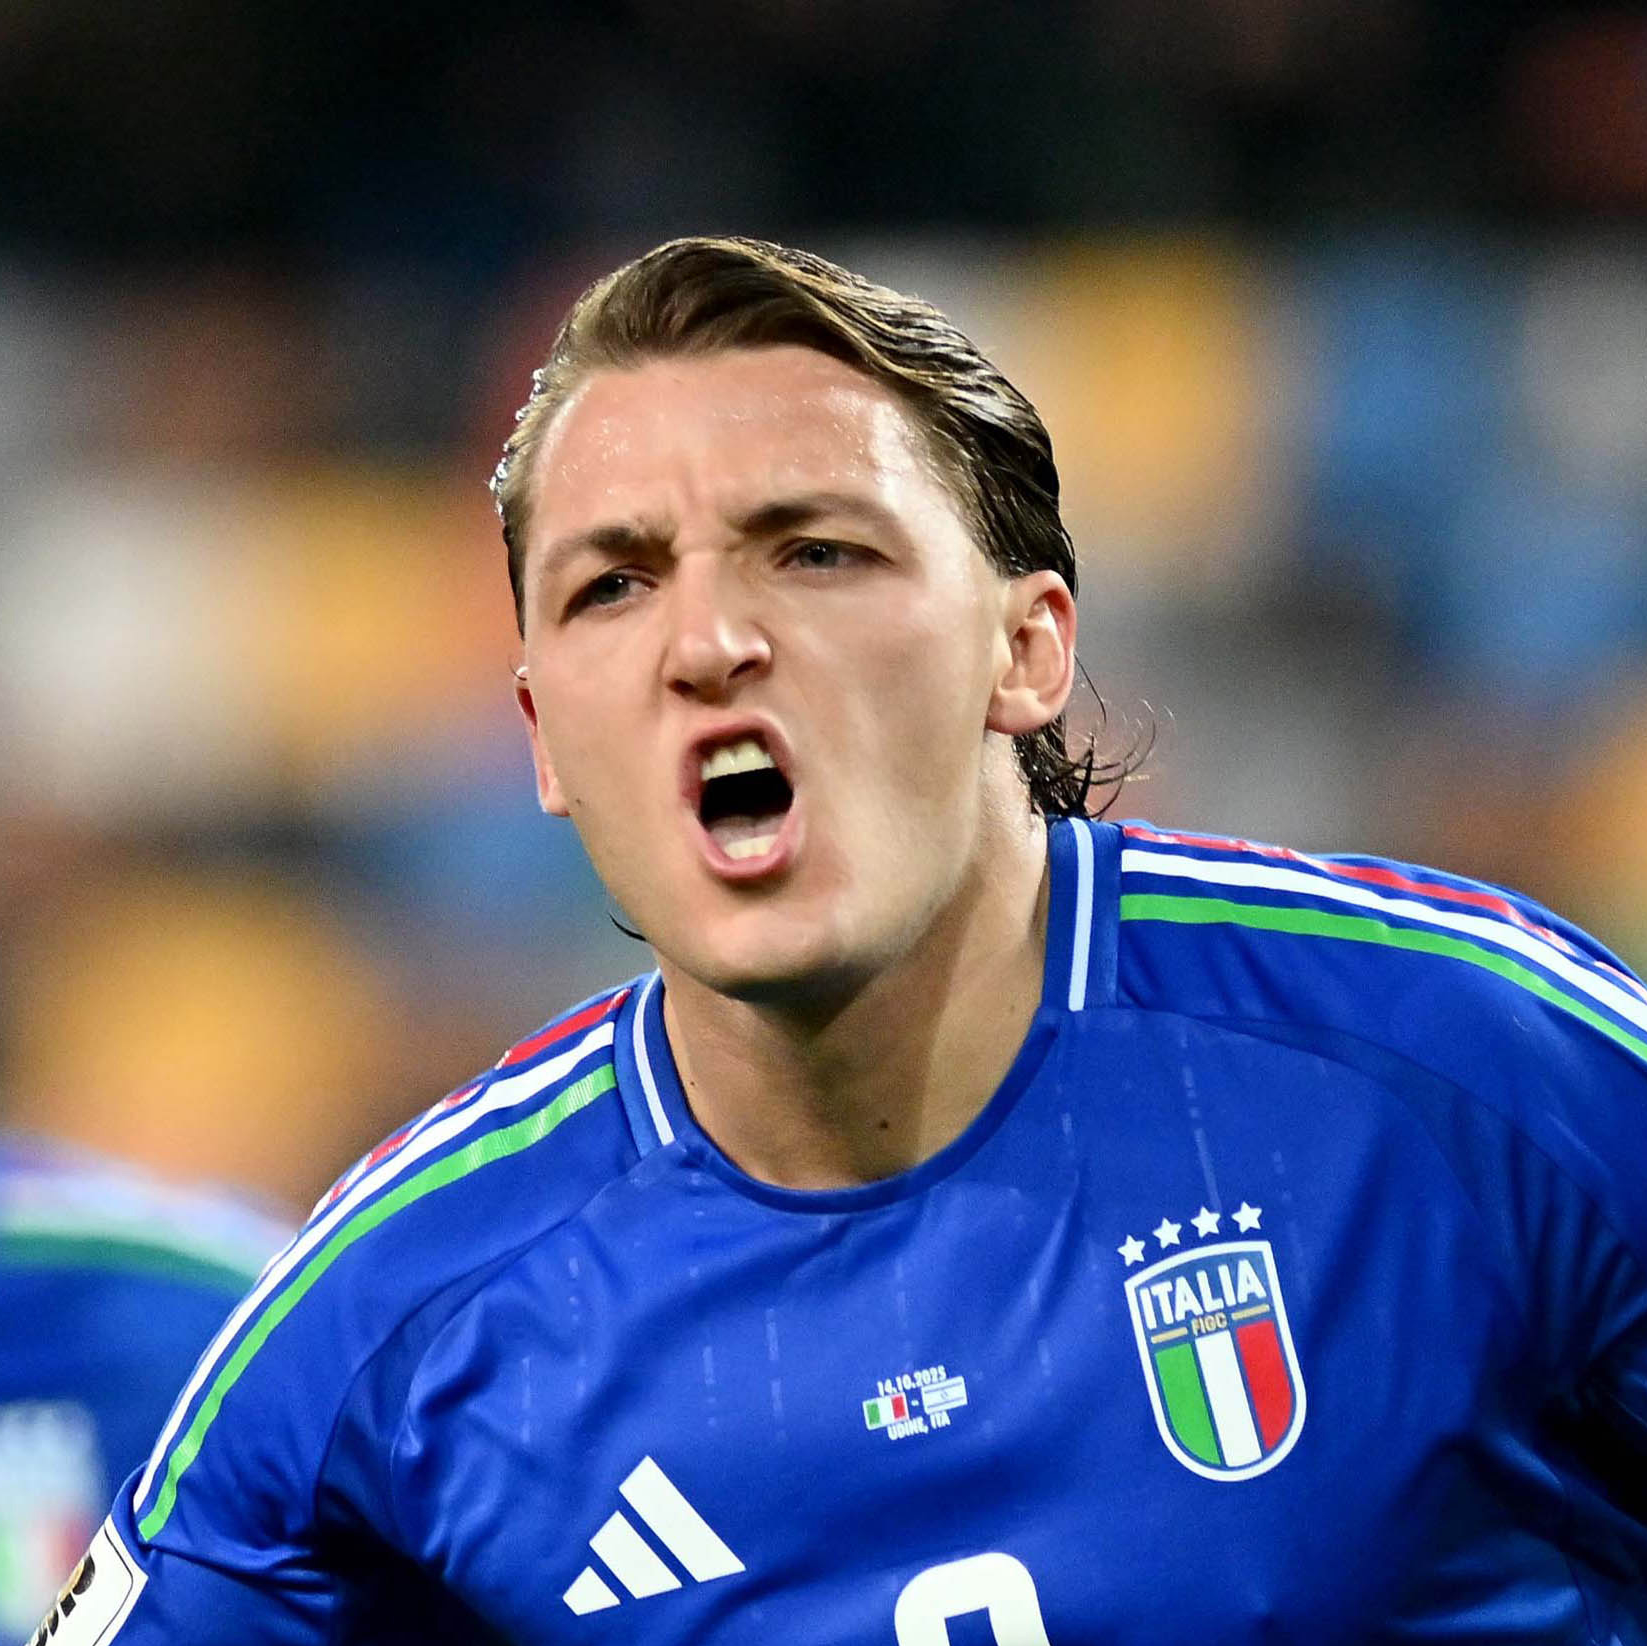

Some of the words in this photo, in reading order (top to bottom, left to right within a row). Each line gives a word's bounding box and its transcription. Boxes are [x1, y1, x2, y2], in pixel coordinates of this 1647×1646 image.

[1139, 1258, 1267, 1331] ITALIA
[1191, 1312, 1228, 1337] FIGC
[877, 1364, 947, 1397] 14.10.2025
[887, 1416, 929, 1440] UDINE,
[930, 1410, 951, 1430] ITA
